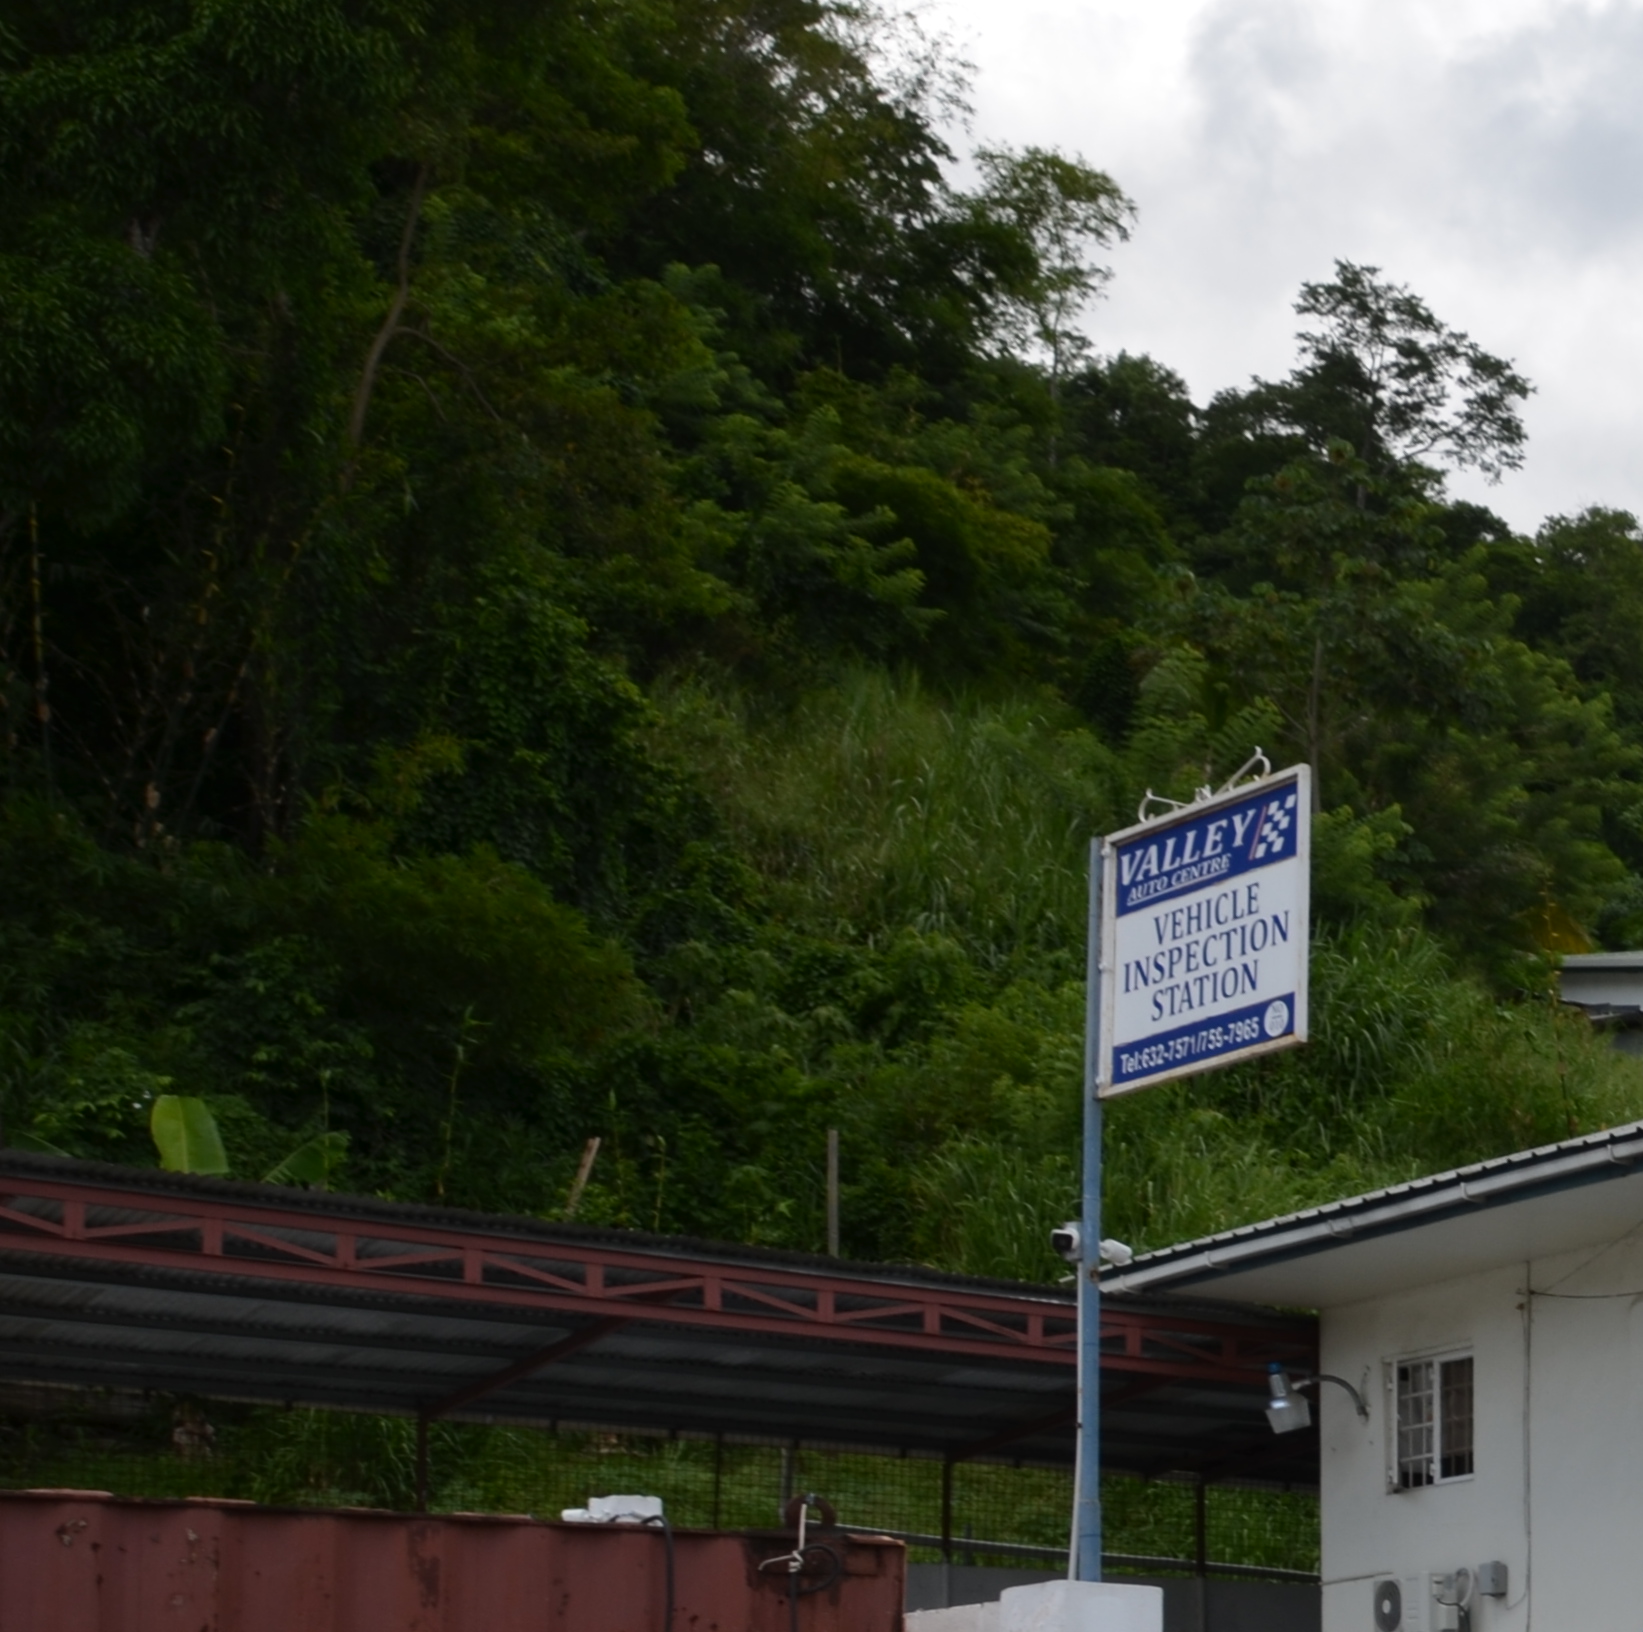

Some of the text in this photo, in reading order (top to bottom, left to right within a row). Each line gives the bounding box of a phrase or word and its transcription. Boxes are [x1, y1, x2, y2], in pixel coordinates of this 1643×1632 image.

[1121, 809, 1256, 886] VALLEY
[1127, 853, 1231, 903] AUTO CENTRE
[1154, 882, 1259, 945] VEHICLE
[1124, 910, 1290, 993] INSPECTION
[1152, 959, 1259, 1021] STATION
